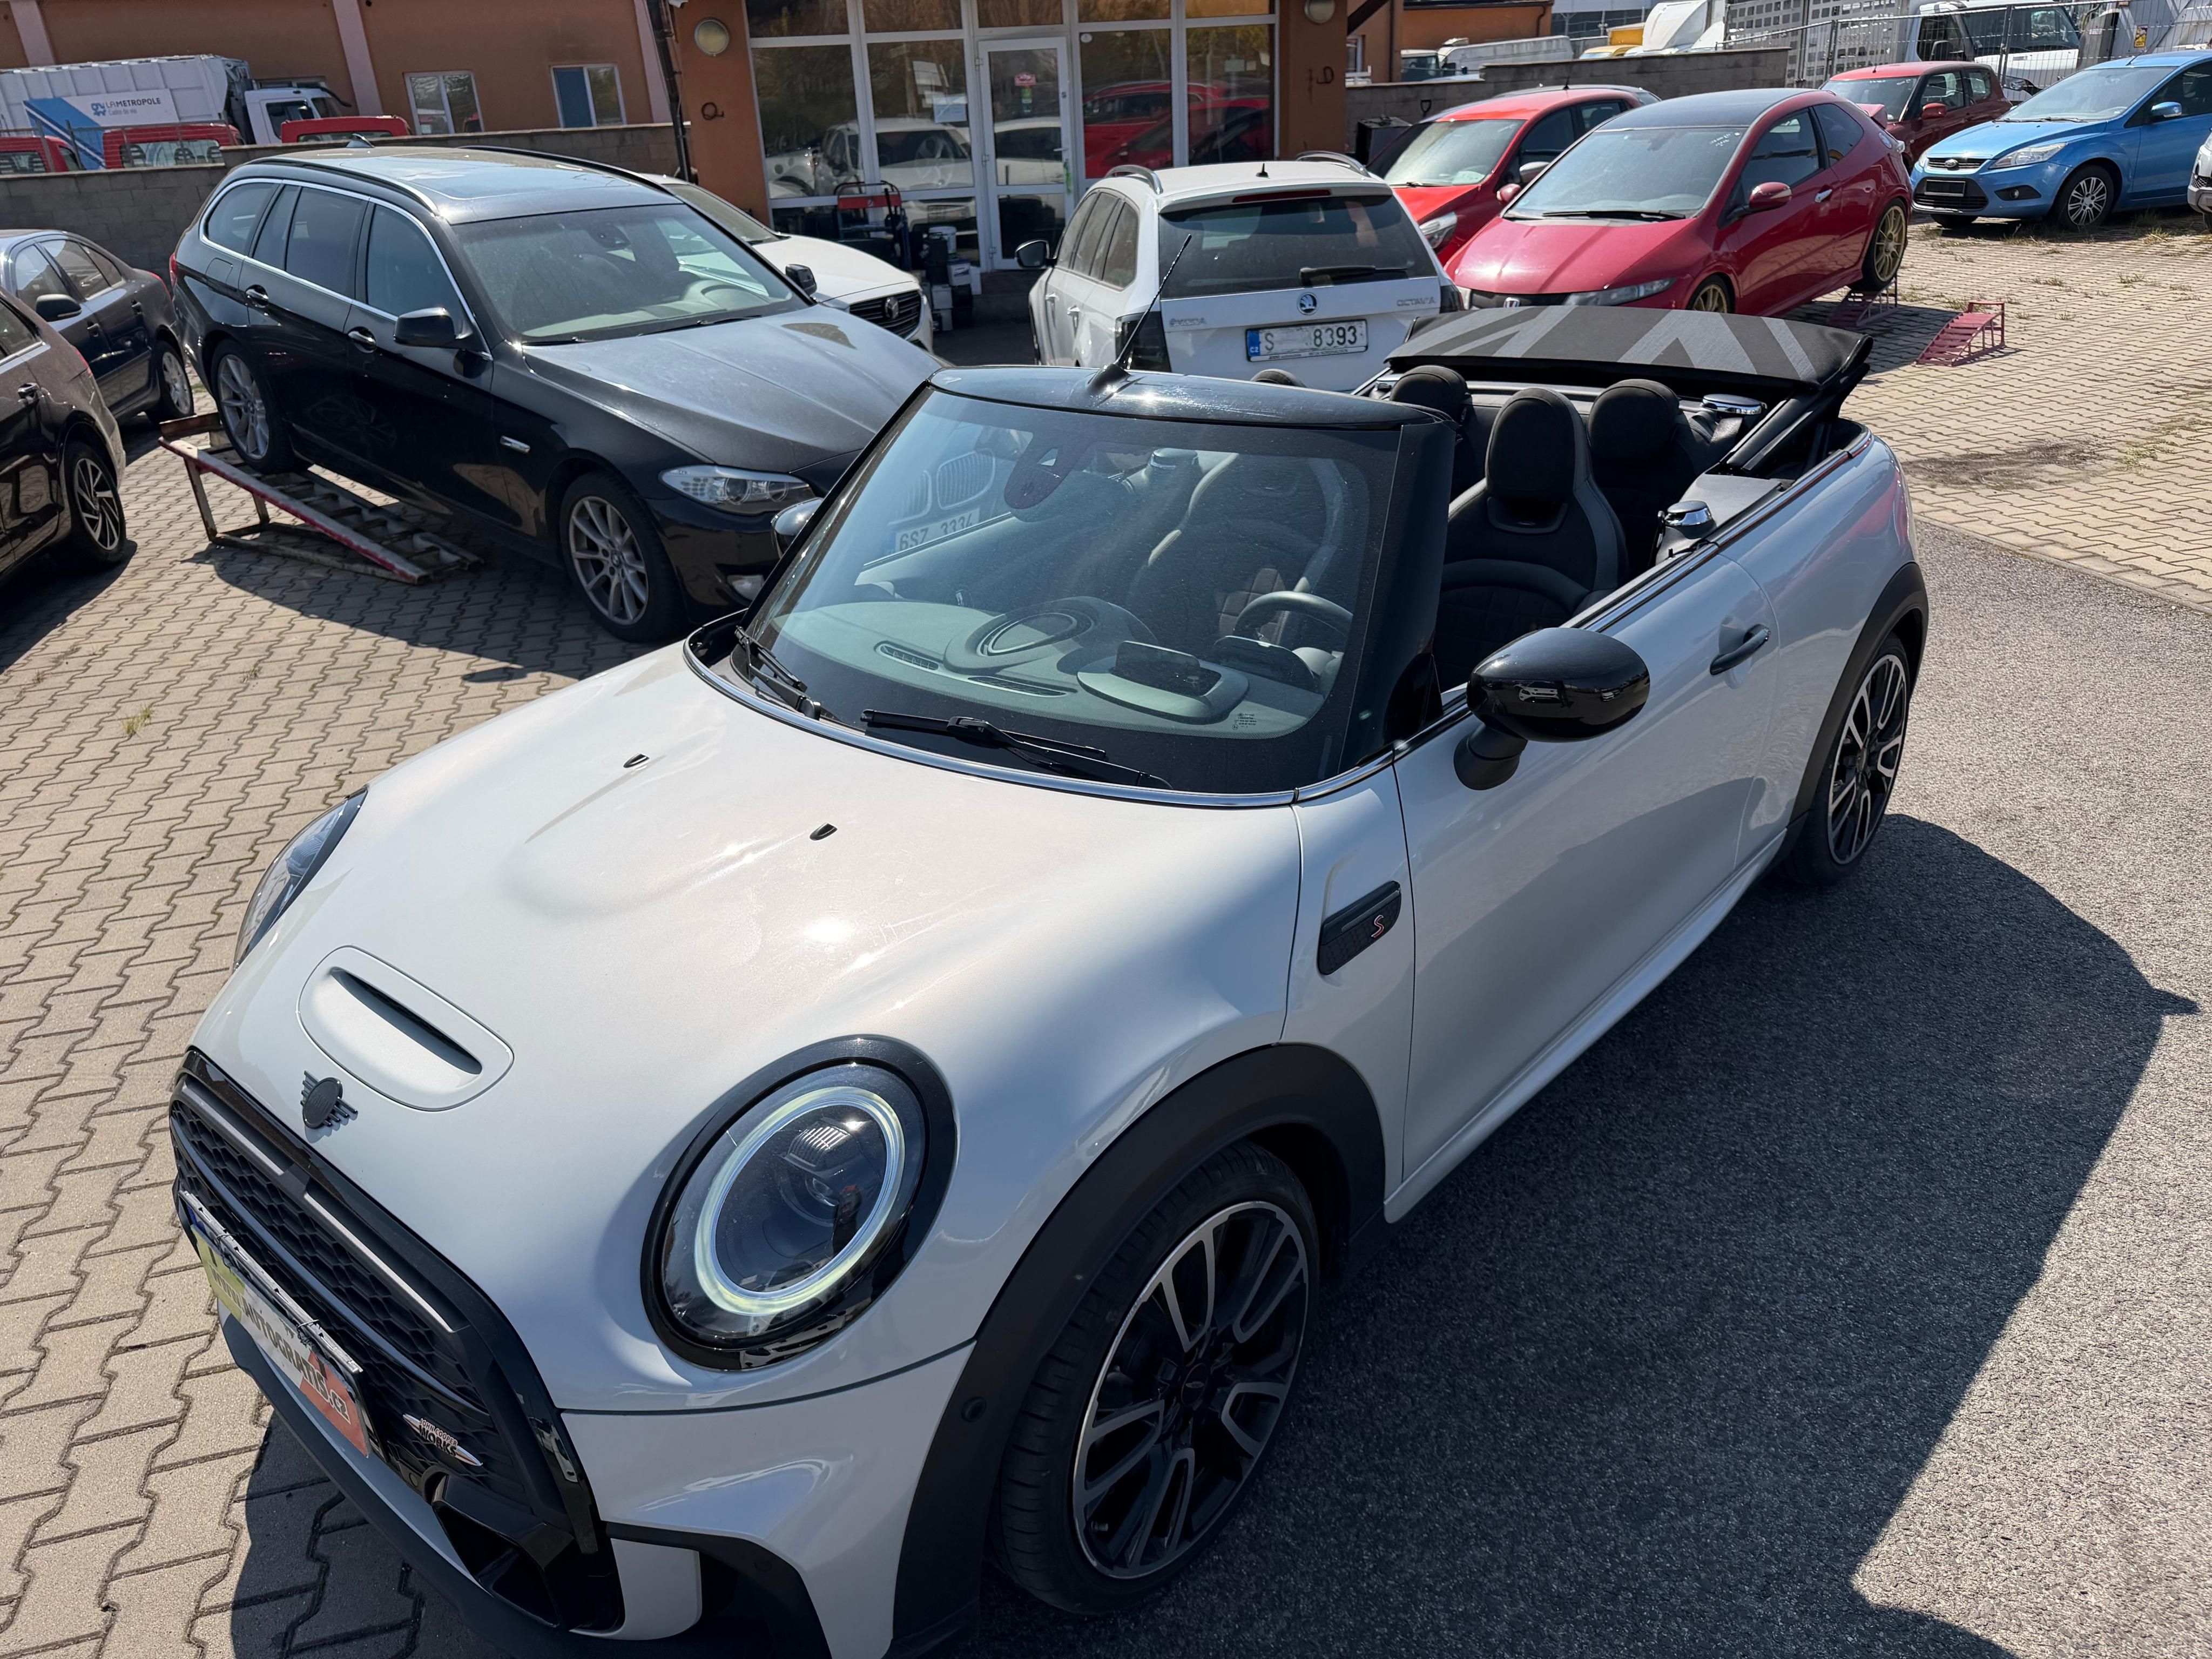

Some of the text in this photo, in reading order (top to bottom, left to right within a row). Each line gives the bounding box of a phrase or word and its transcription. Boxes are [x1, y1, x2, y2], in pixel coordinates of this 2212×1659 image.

[1313, 326, 1357, 348] 8393
[1371, 914, 1384, 939] S
[419, 1424, 457, 1457] WORKS
[420, 1418, 458, 1447] JOHN COOPER
